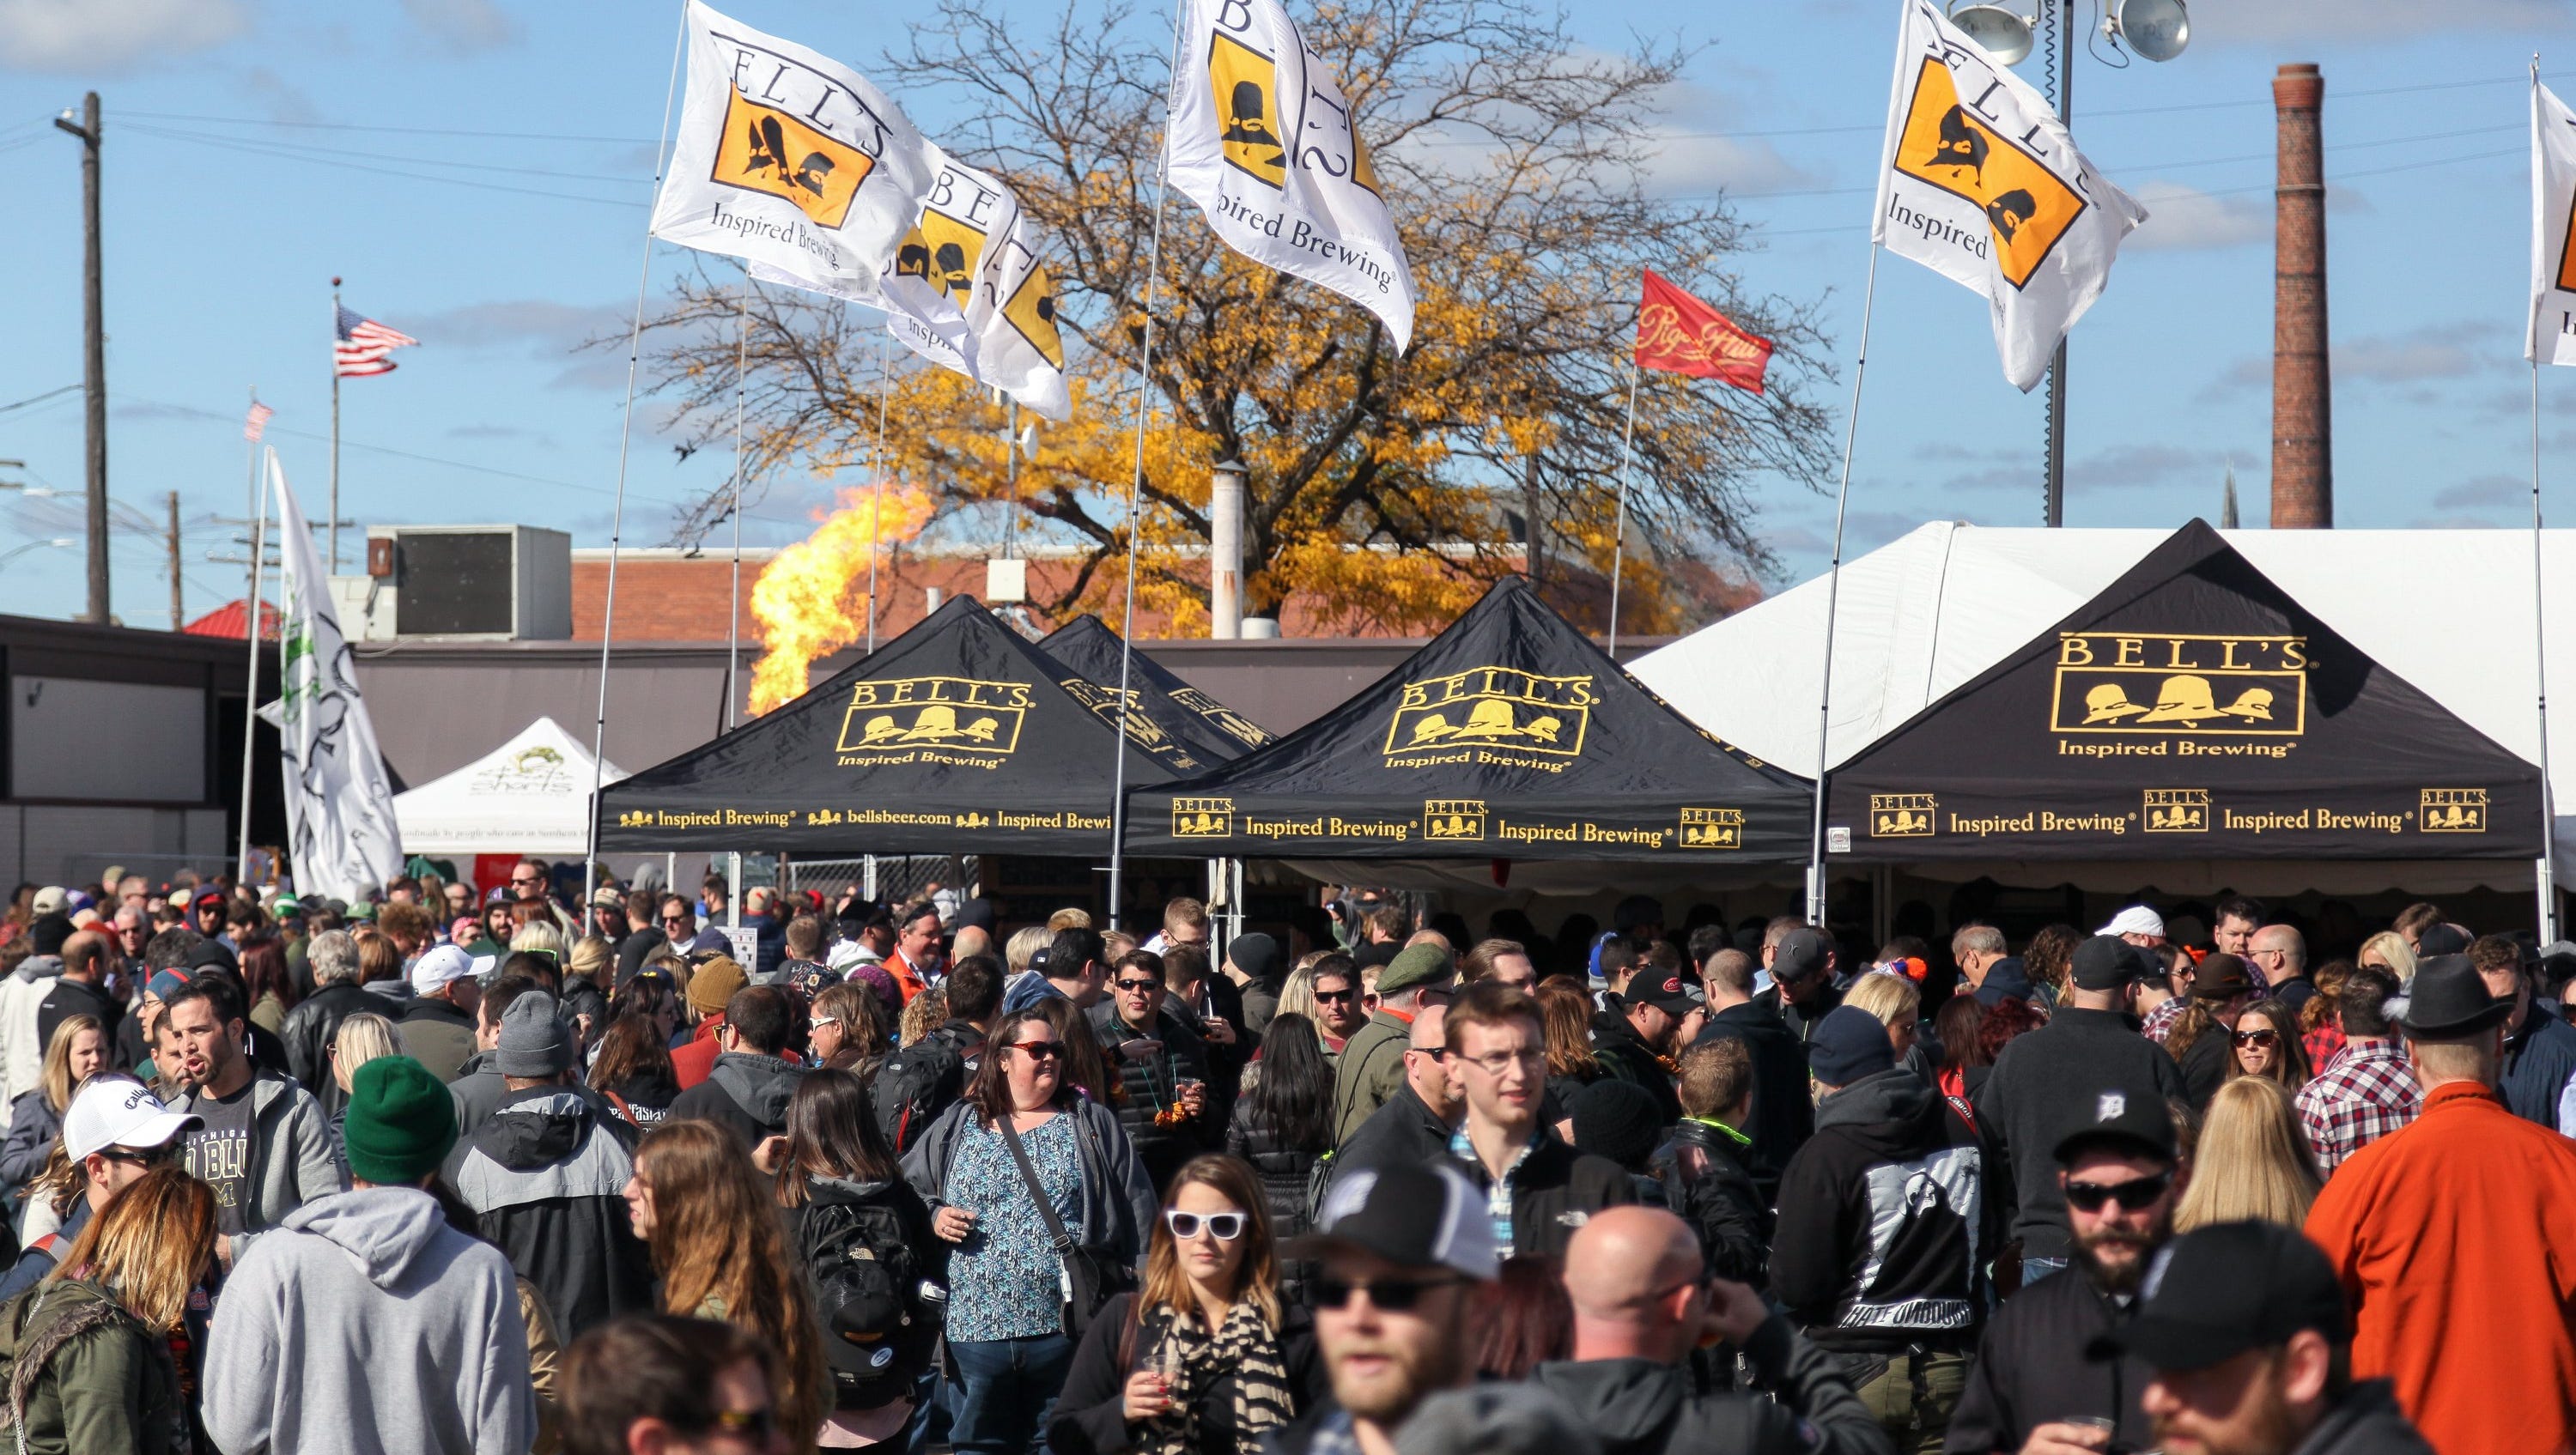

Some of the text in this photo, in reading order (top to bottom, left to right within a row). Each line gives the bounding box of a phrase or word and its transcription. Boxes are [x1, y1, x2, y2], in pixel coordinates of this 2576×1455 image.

[731, 48, 889, 161] ELL'S
[710, 201, 840, 273] Inspired Brewing
[1888, 191, 1988, 261] Inspired
[1217, 191, 1391, 294] pired Brewing
[2057, 638, 2307, 670] BELL'S
[850, 680, 1031, 707] BELL'S
[1399, 670, 1592, 709] BELL'S
[836, 751, 999, 770] Inspired Brewing
[2058, 739, 2288, 759] Inspired Brewing
[1384, 750, 1565, 773] Inspired Brewing
[1172, 799, 1232, 811] BELL'S
[1425, 802, 1485, 814] BELL'S
[1871, 796, 1935, 809] BELL'S
[2144, 791, 2209, 803] BELL'S
[2420, 791, 2487, 803] BELL'S
[658, 809, 789, 829] Inspired Brewing
[847, 809, 951, 825] bellsbeer.com
[997, 810, 1111, 830] Inspired Brewi
[1680, 809, 1742, 822] BELL'S
[1950, 811, 2126, 837] Inspired Brewing
[2224, 808, 2403, 834] Inspired Brewing
[1246, 815, 1408, 841] Inspired Brewing
[1498, 819, 1663, 848] Inspired Brewing
[1947, 1096, 1972, 1119] Canon
